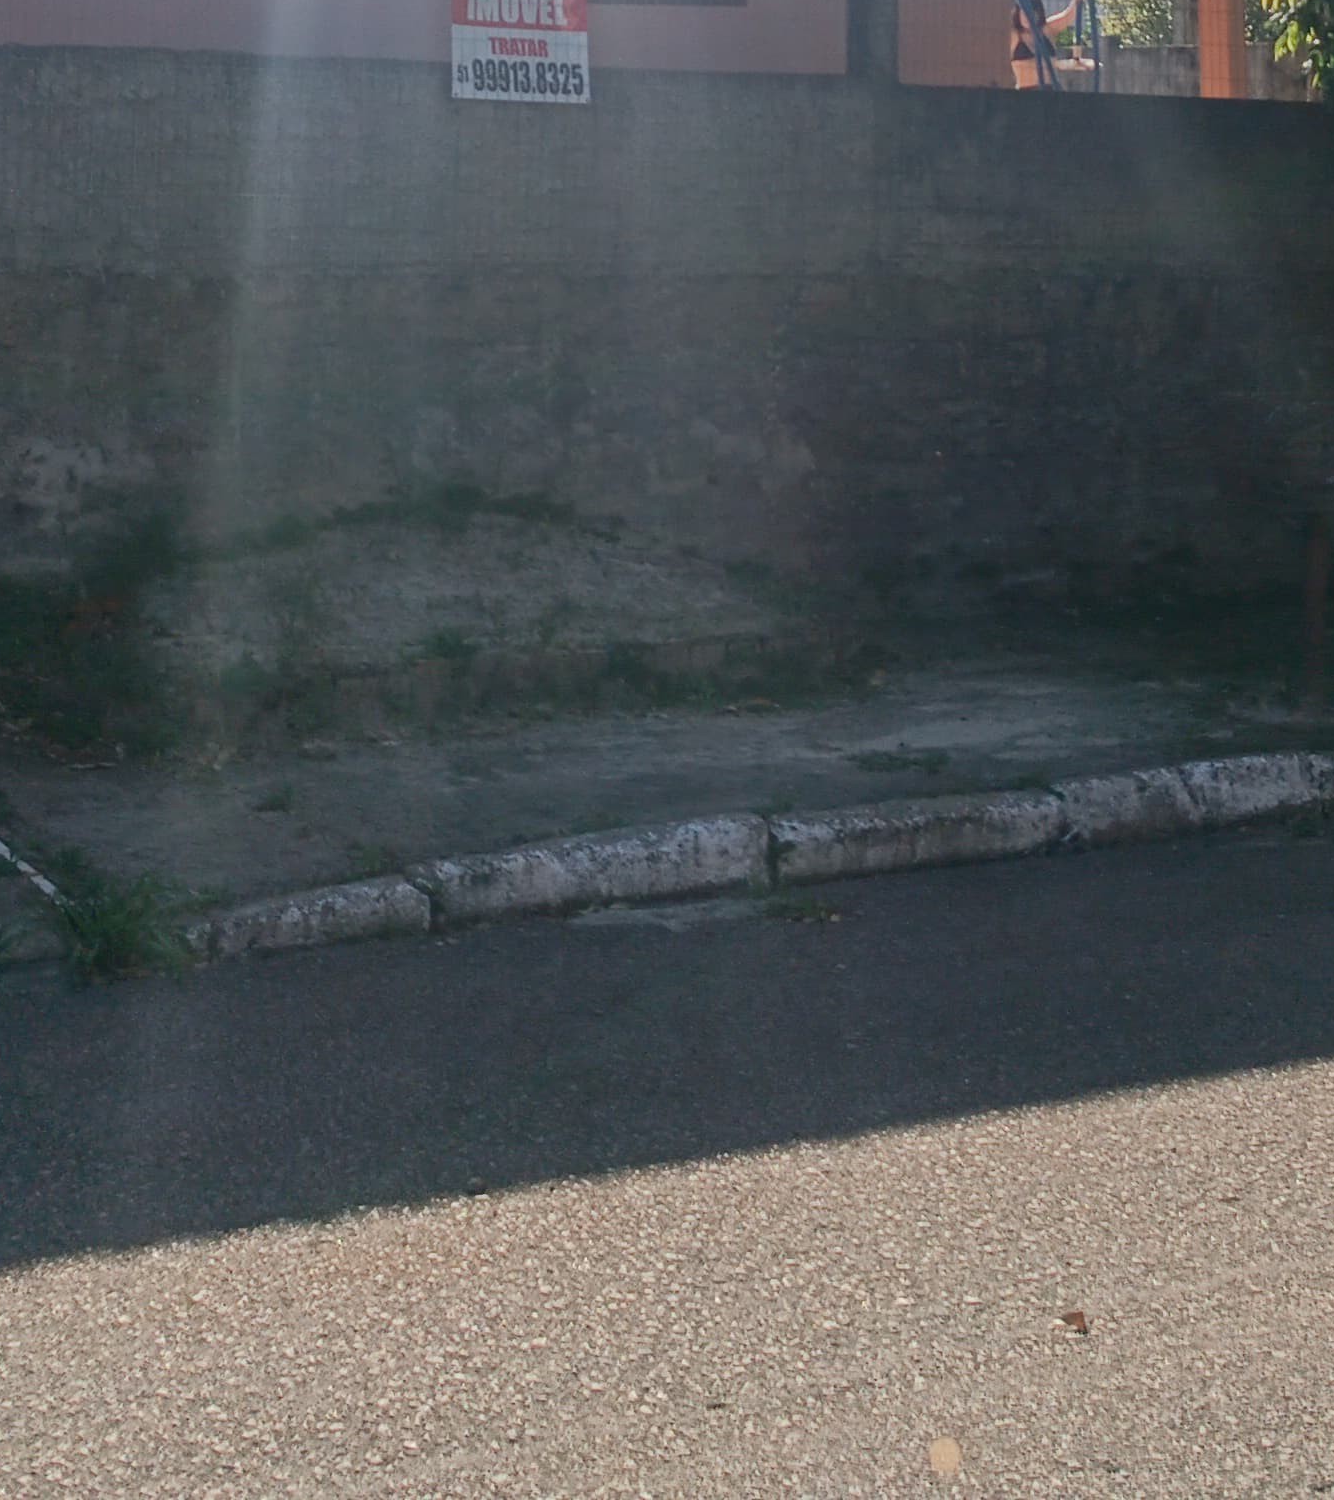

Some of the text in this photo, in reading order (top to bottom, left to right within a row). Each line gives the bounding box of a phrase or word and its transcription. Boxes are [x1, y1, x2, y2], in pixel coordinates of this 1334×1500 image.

[488, 37, 549, 58] TRATAR
[457, 58, 584, 96] 51 99913.8325
